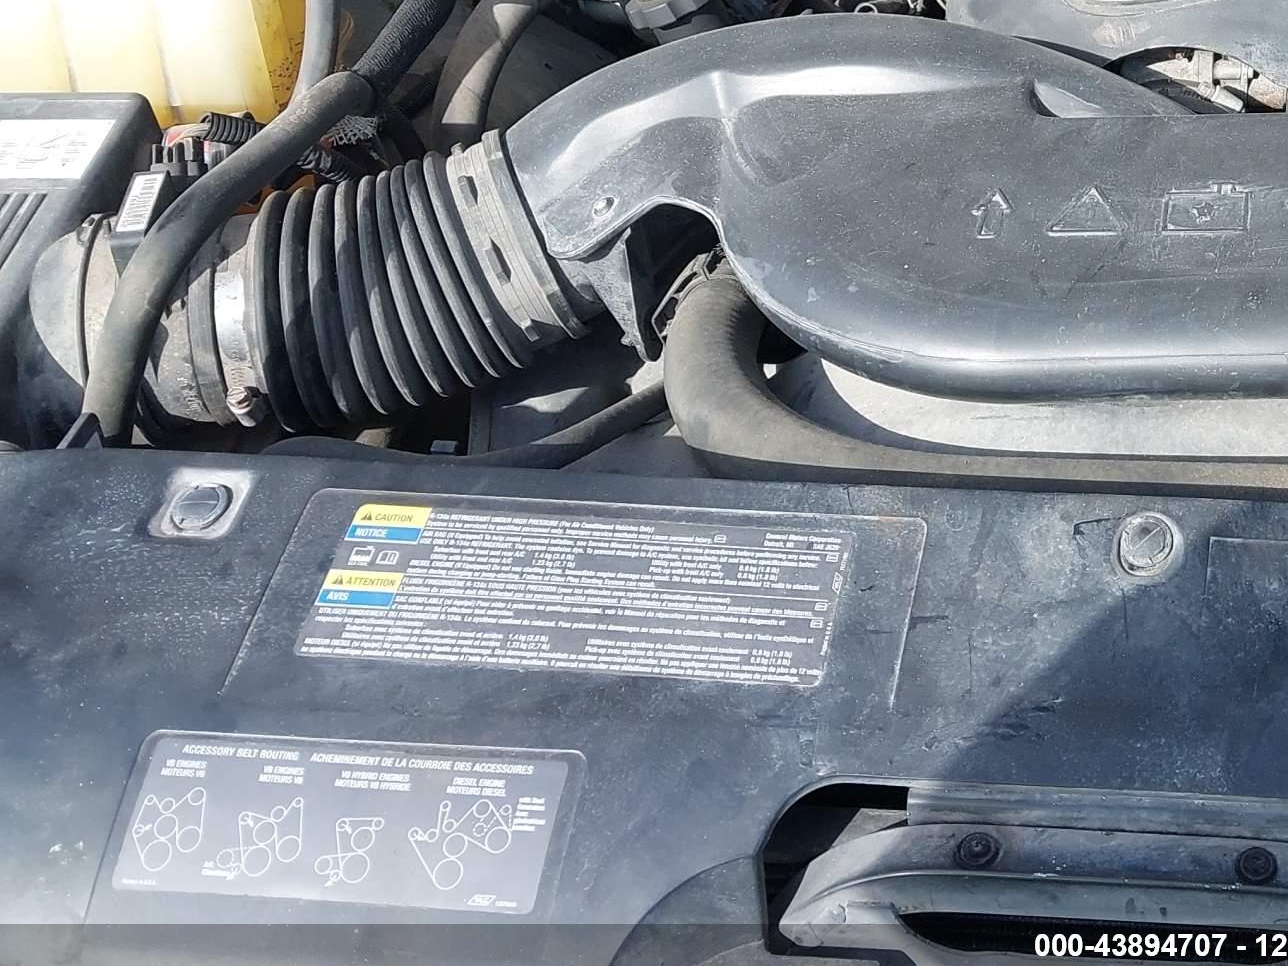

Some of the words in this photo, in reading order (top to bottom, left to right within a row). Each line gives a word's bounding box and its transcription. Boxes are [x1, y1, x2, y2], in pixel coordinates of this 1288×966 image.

[374, 510, 414, 524] CAUTION
[355, 527, 388, 539] NOTICE
[344, 575, 397, 588] ATTENTION
[325, 591, 349, 602] AVIS
[182, 744, 236, 756] ACCESSORY
[235, 747, 258, 758] BELT
[259, 749, 299, 760] ROUTING
[309, 752, 380, 765] ACHEMINEMENT
[380, 756, 395, 766] DE
[394, 757, 408, 767] LA
[407, 758, 453, 770] COURROIE
[452, 761, 473, 771] DES
[472, 762, 534, 774] ACCESSOIRES
